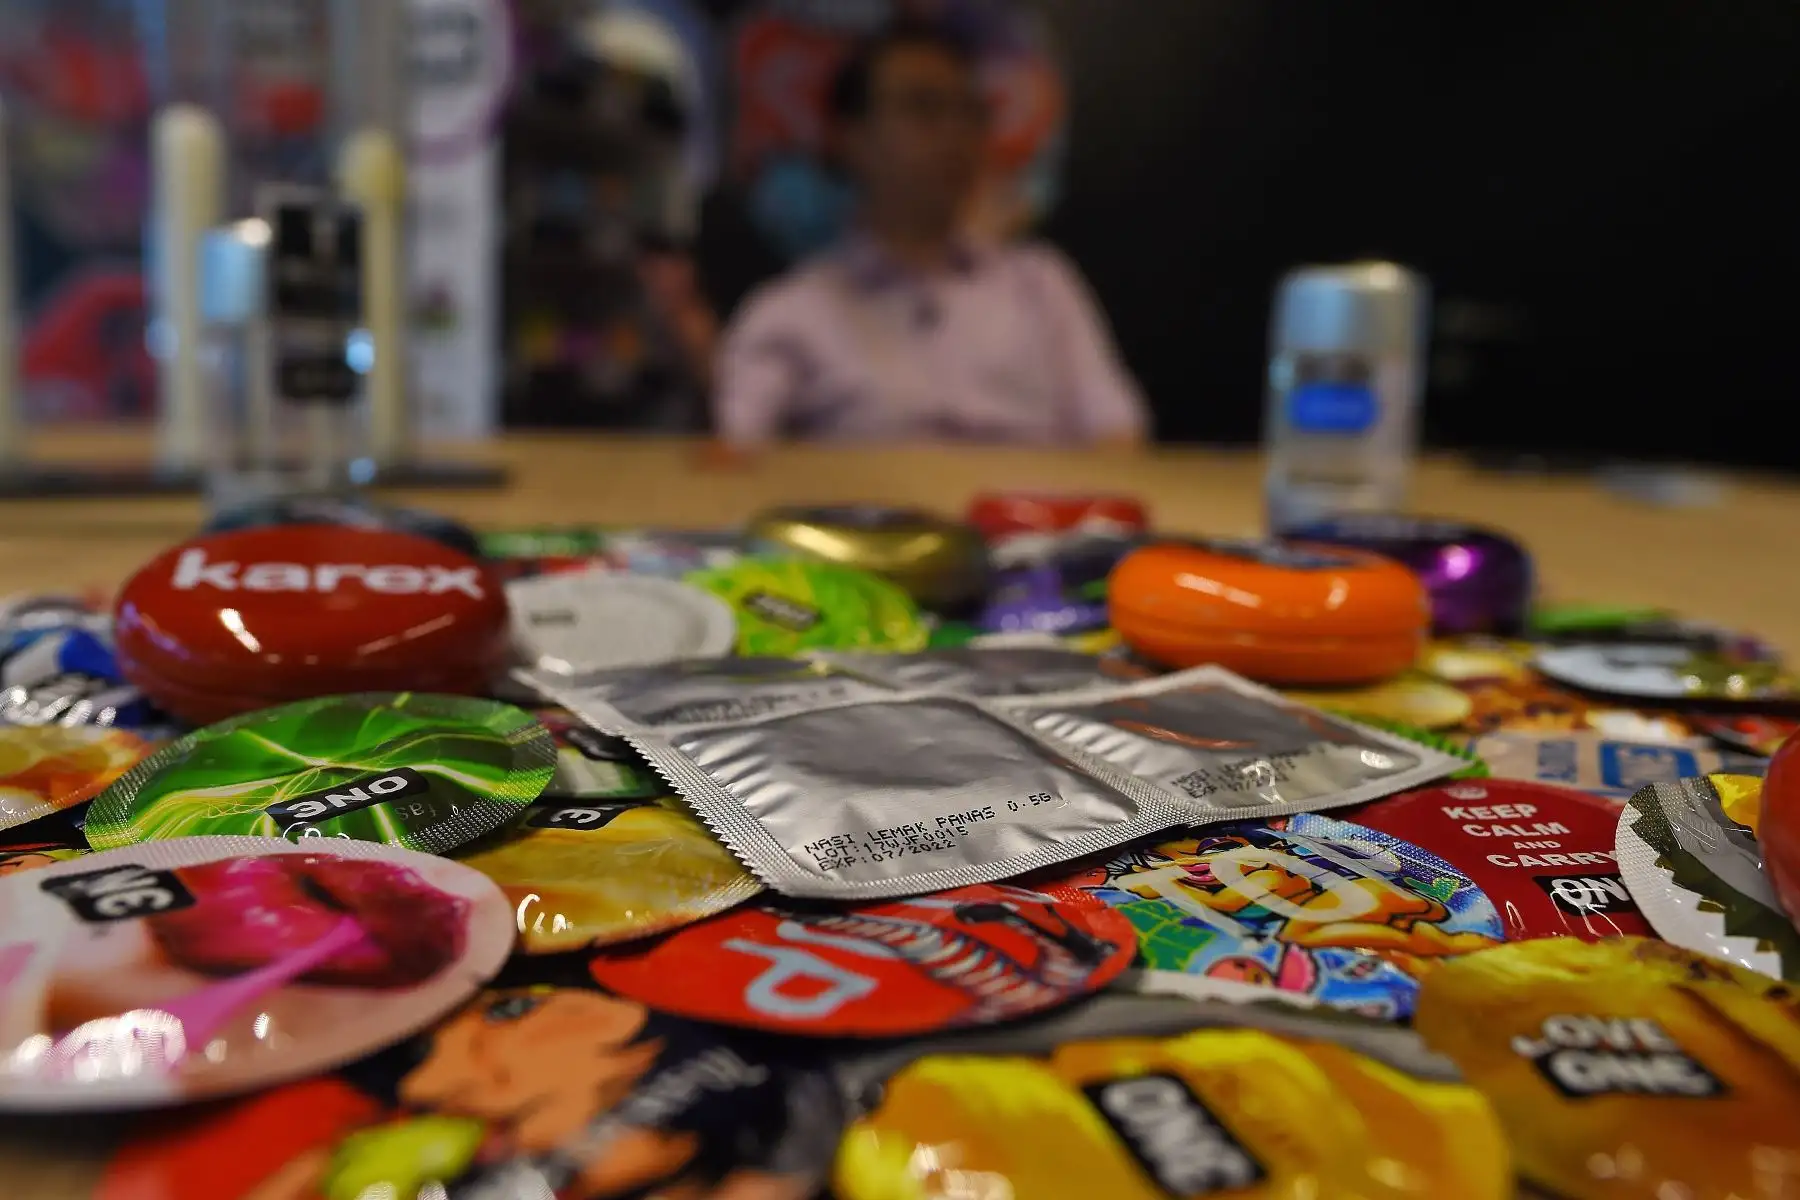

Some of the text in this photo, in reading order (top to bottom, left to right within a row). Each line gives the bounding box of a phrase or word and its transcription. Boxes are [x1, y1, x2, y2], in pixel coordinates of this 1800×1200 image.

[286, 776, 408, 818] ONE
[1441, 803, 1539, 821] KEEP
[804, 792, 1052, 855] NASI LEMAK PANAS 0.5G
[1462, 822, 1572, 838] CALM
[1513, 840, 1562, 850] AND
